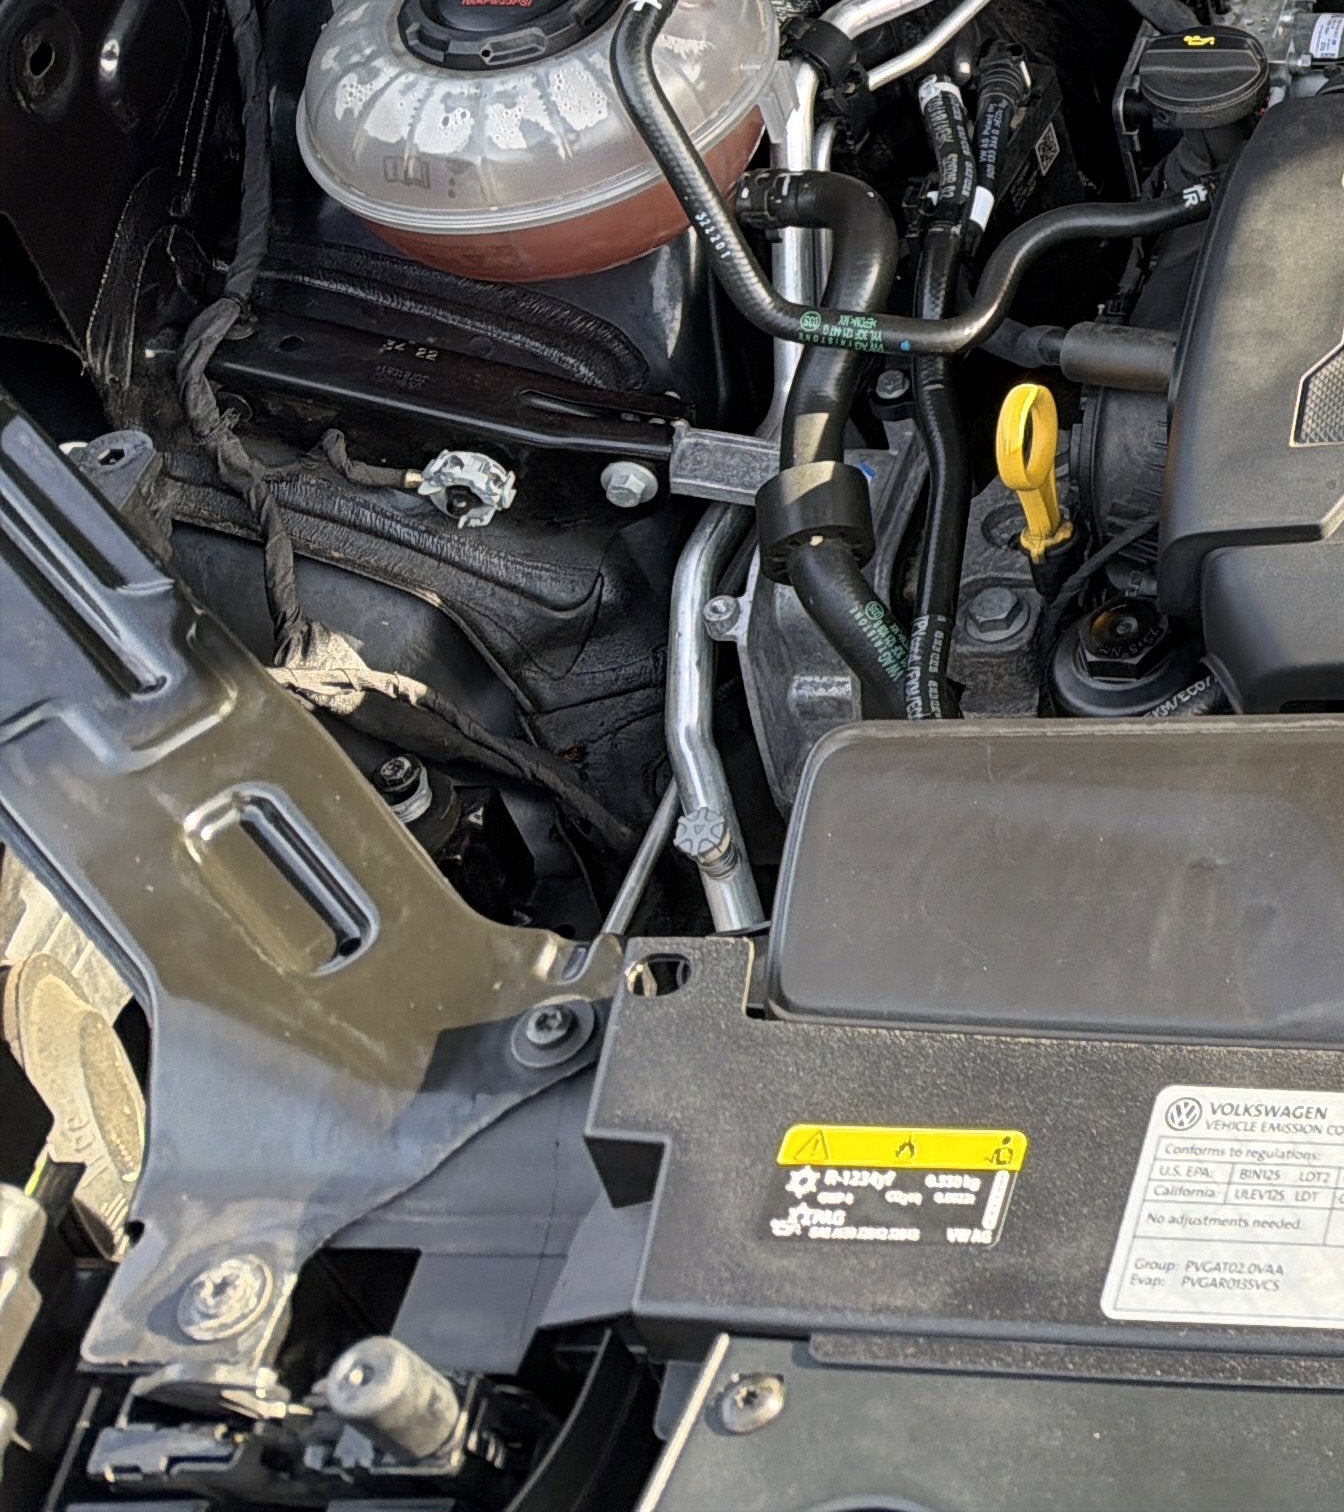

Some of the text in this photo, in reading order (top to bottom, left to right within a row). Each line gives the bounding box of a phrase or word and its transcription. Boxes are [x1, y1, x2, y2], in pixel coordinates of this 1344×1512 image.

[415, 348, 438, 362] 22
[1210, 1102, 1328, 1120] VOLKSWAGEN
[1206, 1120, 1258, 1133] VEHICLE
[1261, 1122, 1323, 1135] EMISSION
[1165, 1144, 1226, 1157] Conforms
[1229, 1146, 1242, 1158] to
[1147, 1213, 1167, 1226] No
[1170, 1213, 1248, 1231] adjustments
